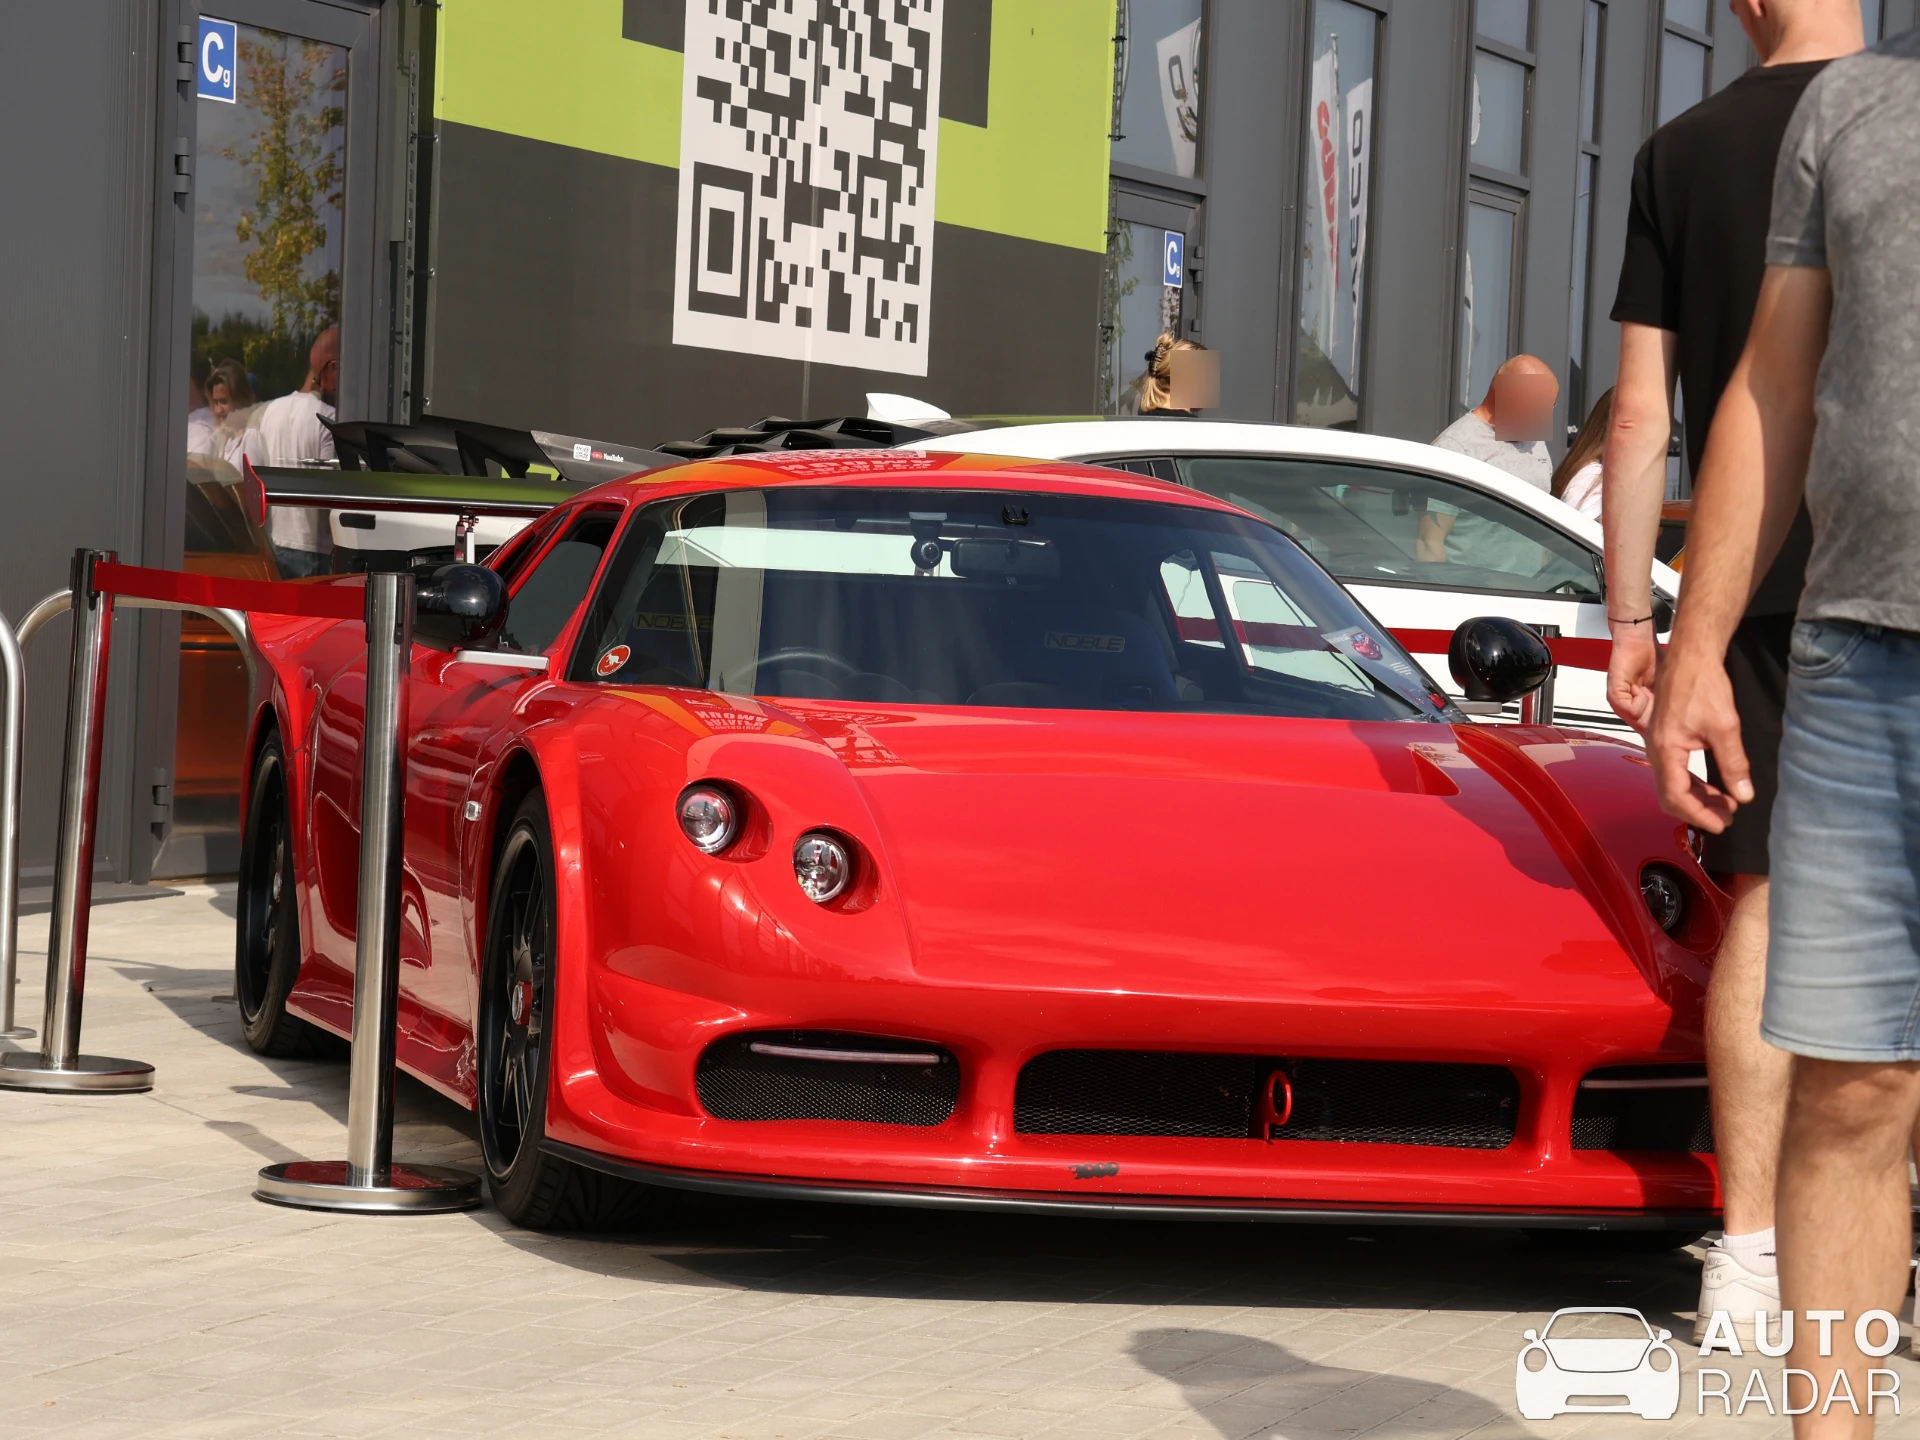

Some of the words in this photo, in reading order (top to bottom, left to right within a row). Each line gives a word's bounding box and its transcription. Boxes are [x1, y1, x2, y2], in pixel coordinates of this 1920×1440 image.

[603, 453, 624, 463] YouTube
[636, 613, 712, 630] NOBE
[1047, 633, 1123, 651] NOBLE
[1706, 1257, 1722, 1266] NIKE
[1705, 1272, 1722, 1280] AIR
